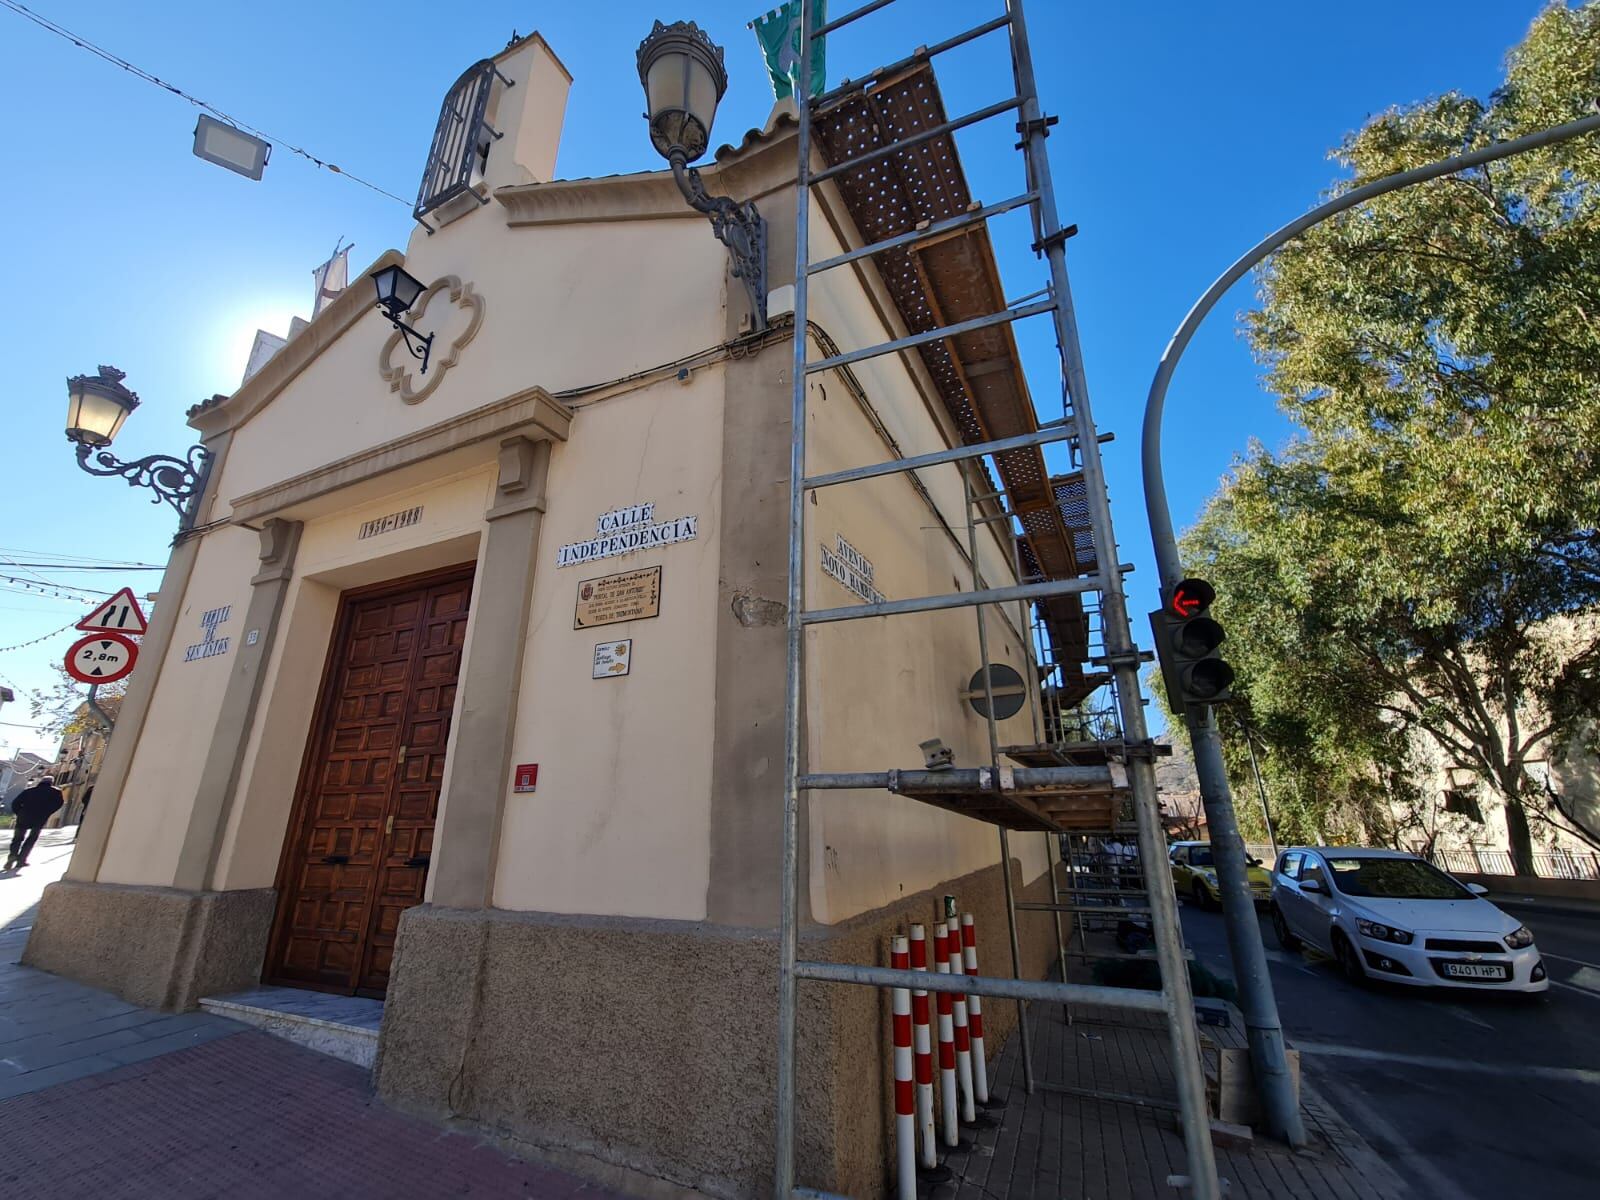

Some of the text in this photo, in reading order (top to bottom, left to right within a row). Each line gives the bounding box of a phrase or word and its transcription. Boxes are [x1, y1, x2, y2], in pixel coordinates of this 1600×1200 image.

[363, 507, 420, 538] 1950-1988
[601, 506, 651, 531] CALLE
[563, 521, 693, 563] INDEPENDENCIA
[823, 549, 846, 581] NOVO
[838, 541, 873, 580] AVENIDA
[83, 650, 118, 662] 2,8m
[1450, 964, 1502, 977] 9401 HPT
